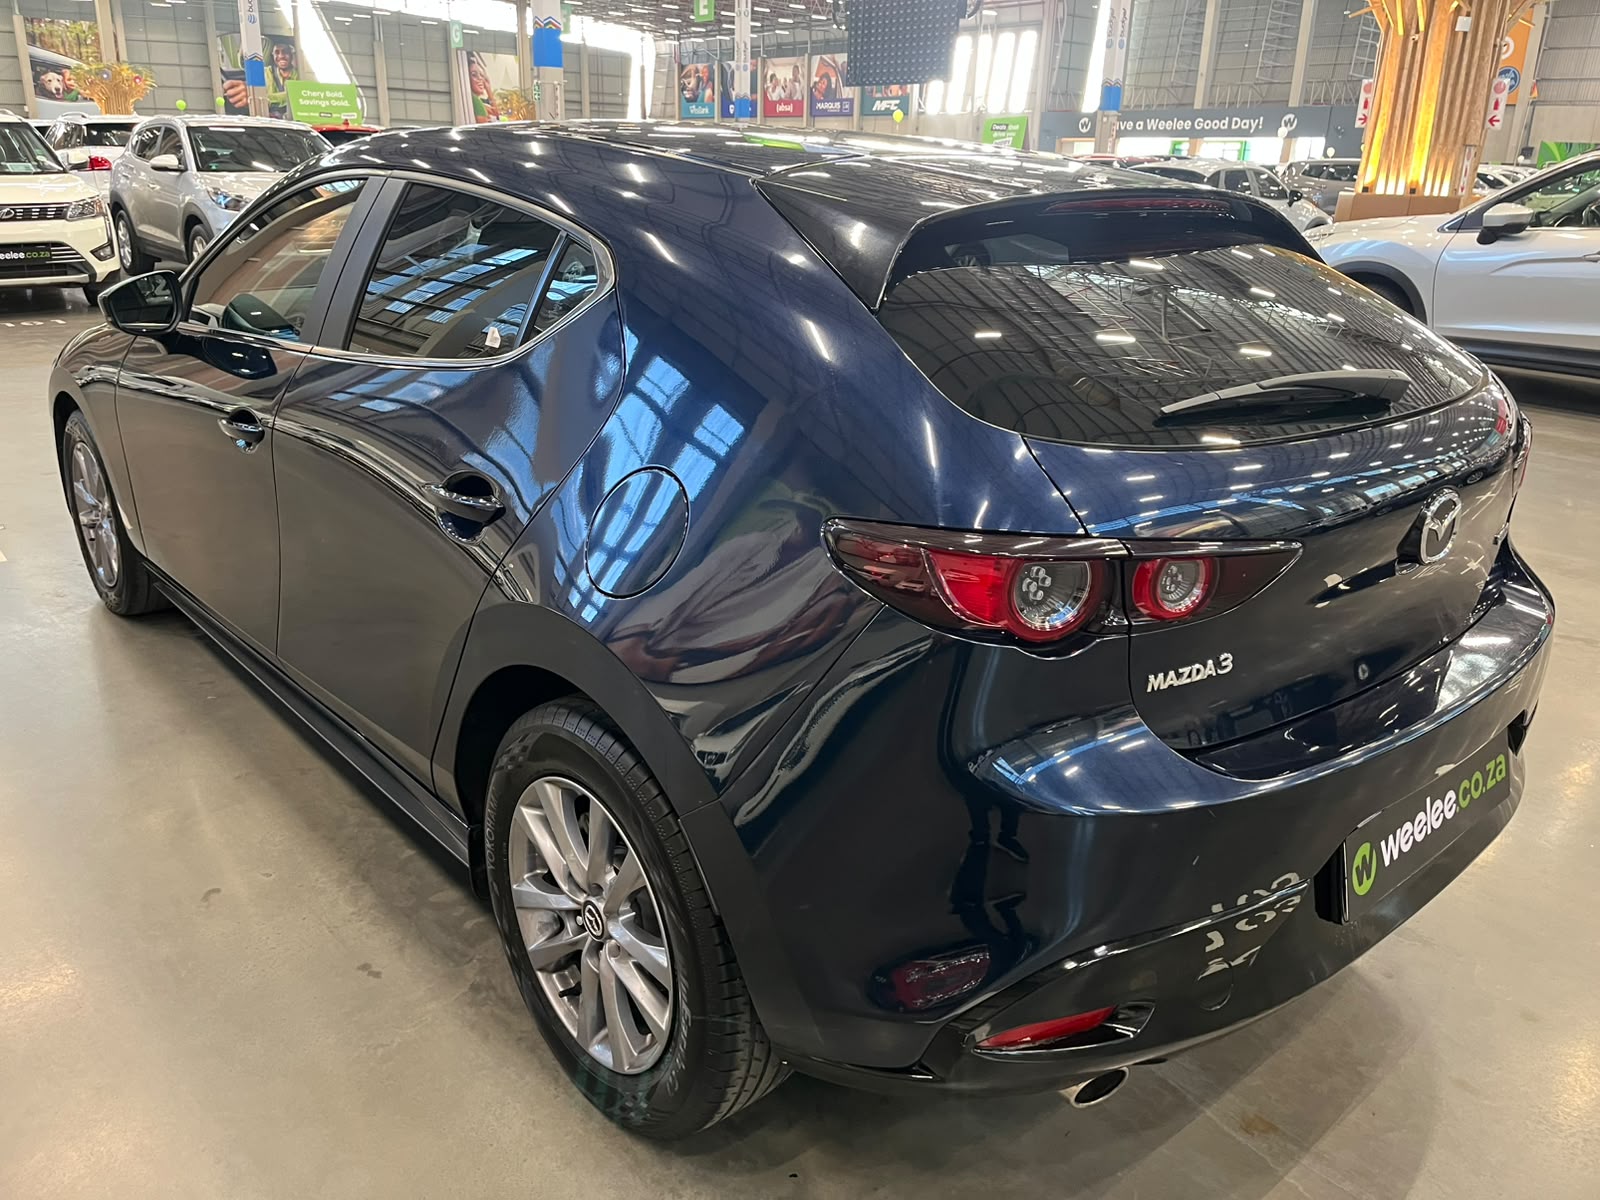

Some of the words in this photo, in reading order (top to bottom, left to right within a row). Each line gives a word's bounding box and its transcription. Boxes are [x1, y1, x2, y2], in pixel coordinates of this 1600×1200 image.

[453, 24, 461, 43] G
[301, 90, 324, 98] Chery
[299, 99, 330, 107] Savings
[872, 100, 900, 111] MFC
[1136, 121, 1144, 131] a
[1146, 118, 1192, 131] Weelee
[1194, 117, 1229, 130] Good
[1231, 116, 1264, 134] Day!
[1380, 753, 1507, 868] weelee.co.za
